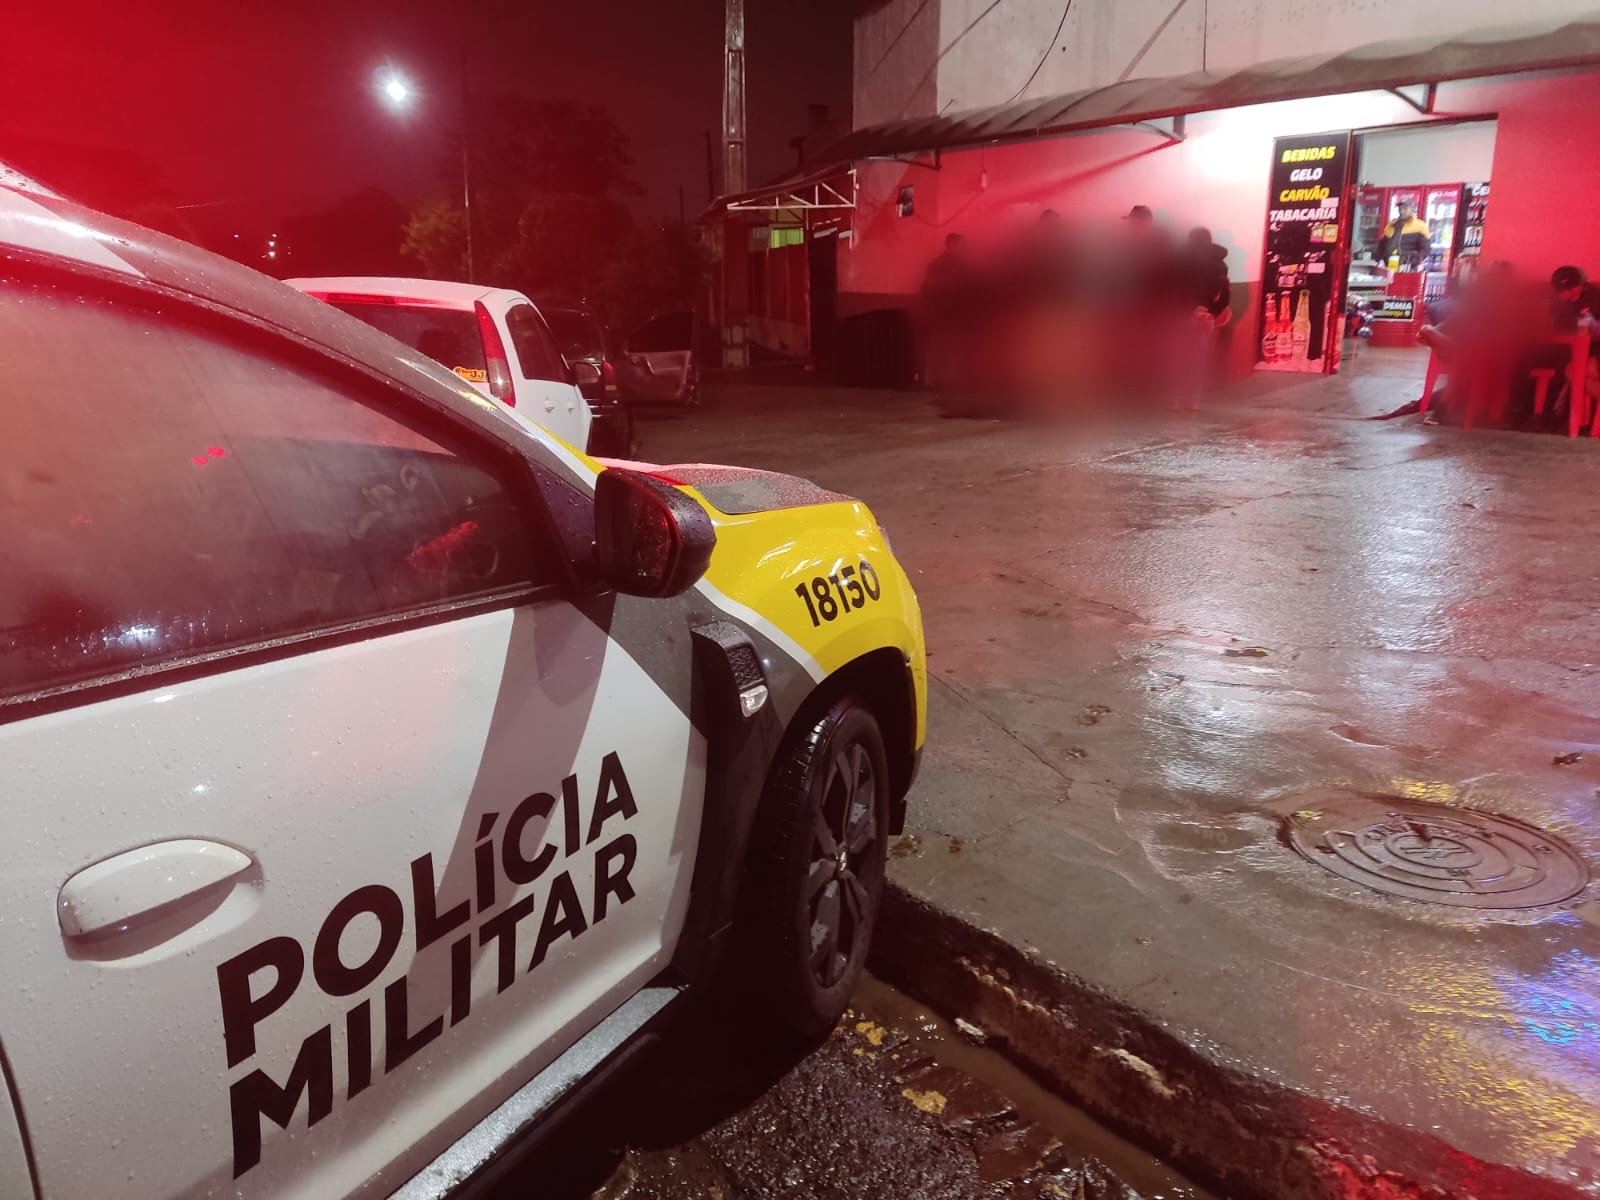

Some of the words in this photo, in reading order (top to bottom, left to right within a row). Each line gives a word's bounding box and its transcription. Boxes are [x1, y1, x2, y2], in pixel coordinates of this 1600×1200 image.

[1281, 146, 1336, 163] BEBIDAS
[1290, 167, 1323, 182] GELO
[1280, 185, 1330, 202] CARVÃO
[1269, 207, 1337, 222] TABACARIA
[795, 560, 880, 628] 18150
[216, 750, 638, 1070] POLÍCIA
[229, 833, 637, 1180] MILITAR
